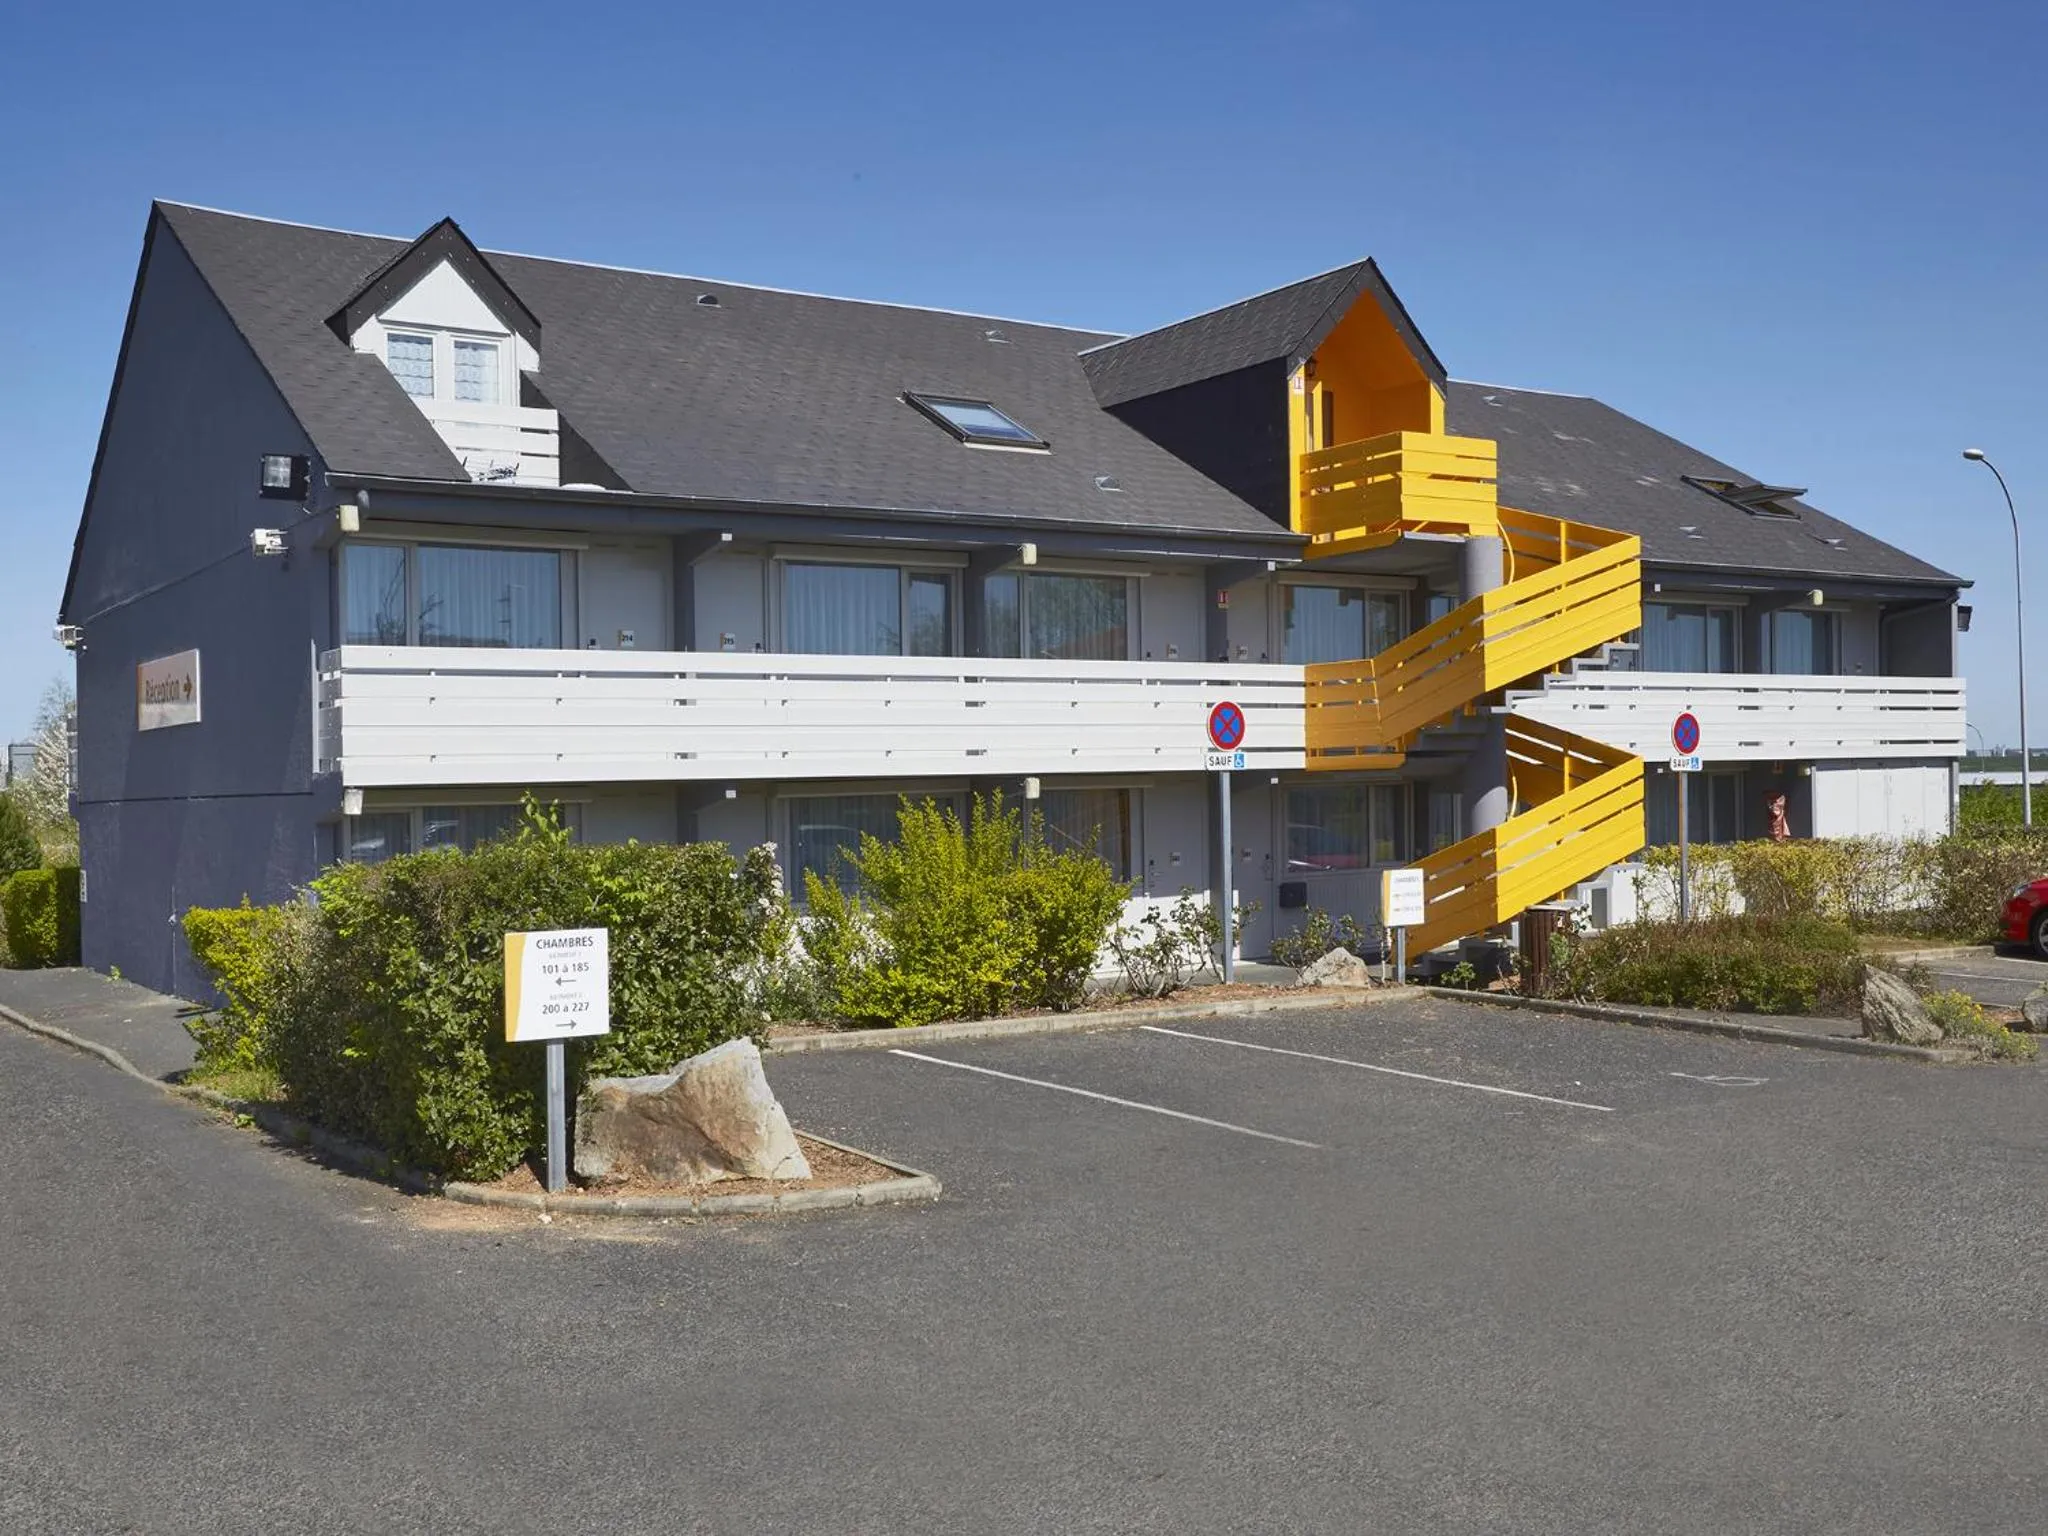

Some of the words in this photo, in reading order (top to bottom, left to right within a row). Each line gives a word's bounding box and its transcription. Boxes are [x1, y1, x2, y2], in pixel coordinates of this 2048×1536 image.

[1209, 756, 1232, 766] SAUF
[536, 936, 594, 949] CHAMBRES
[541, 964, 559, 974] 101
[572, 962, 590, 972] 185
[542, 1004, 560, 1014] 200
[572, 1002, 590, 1012] 227
